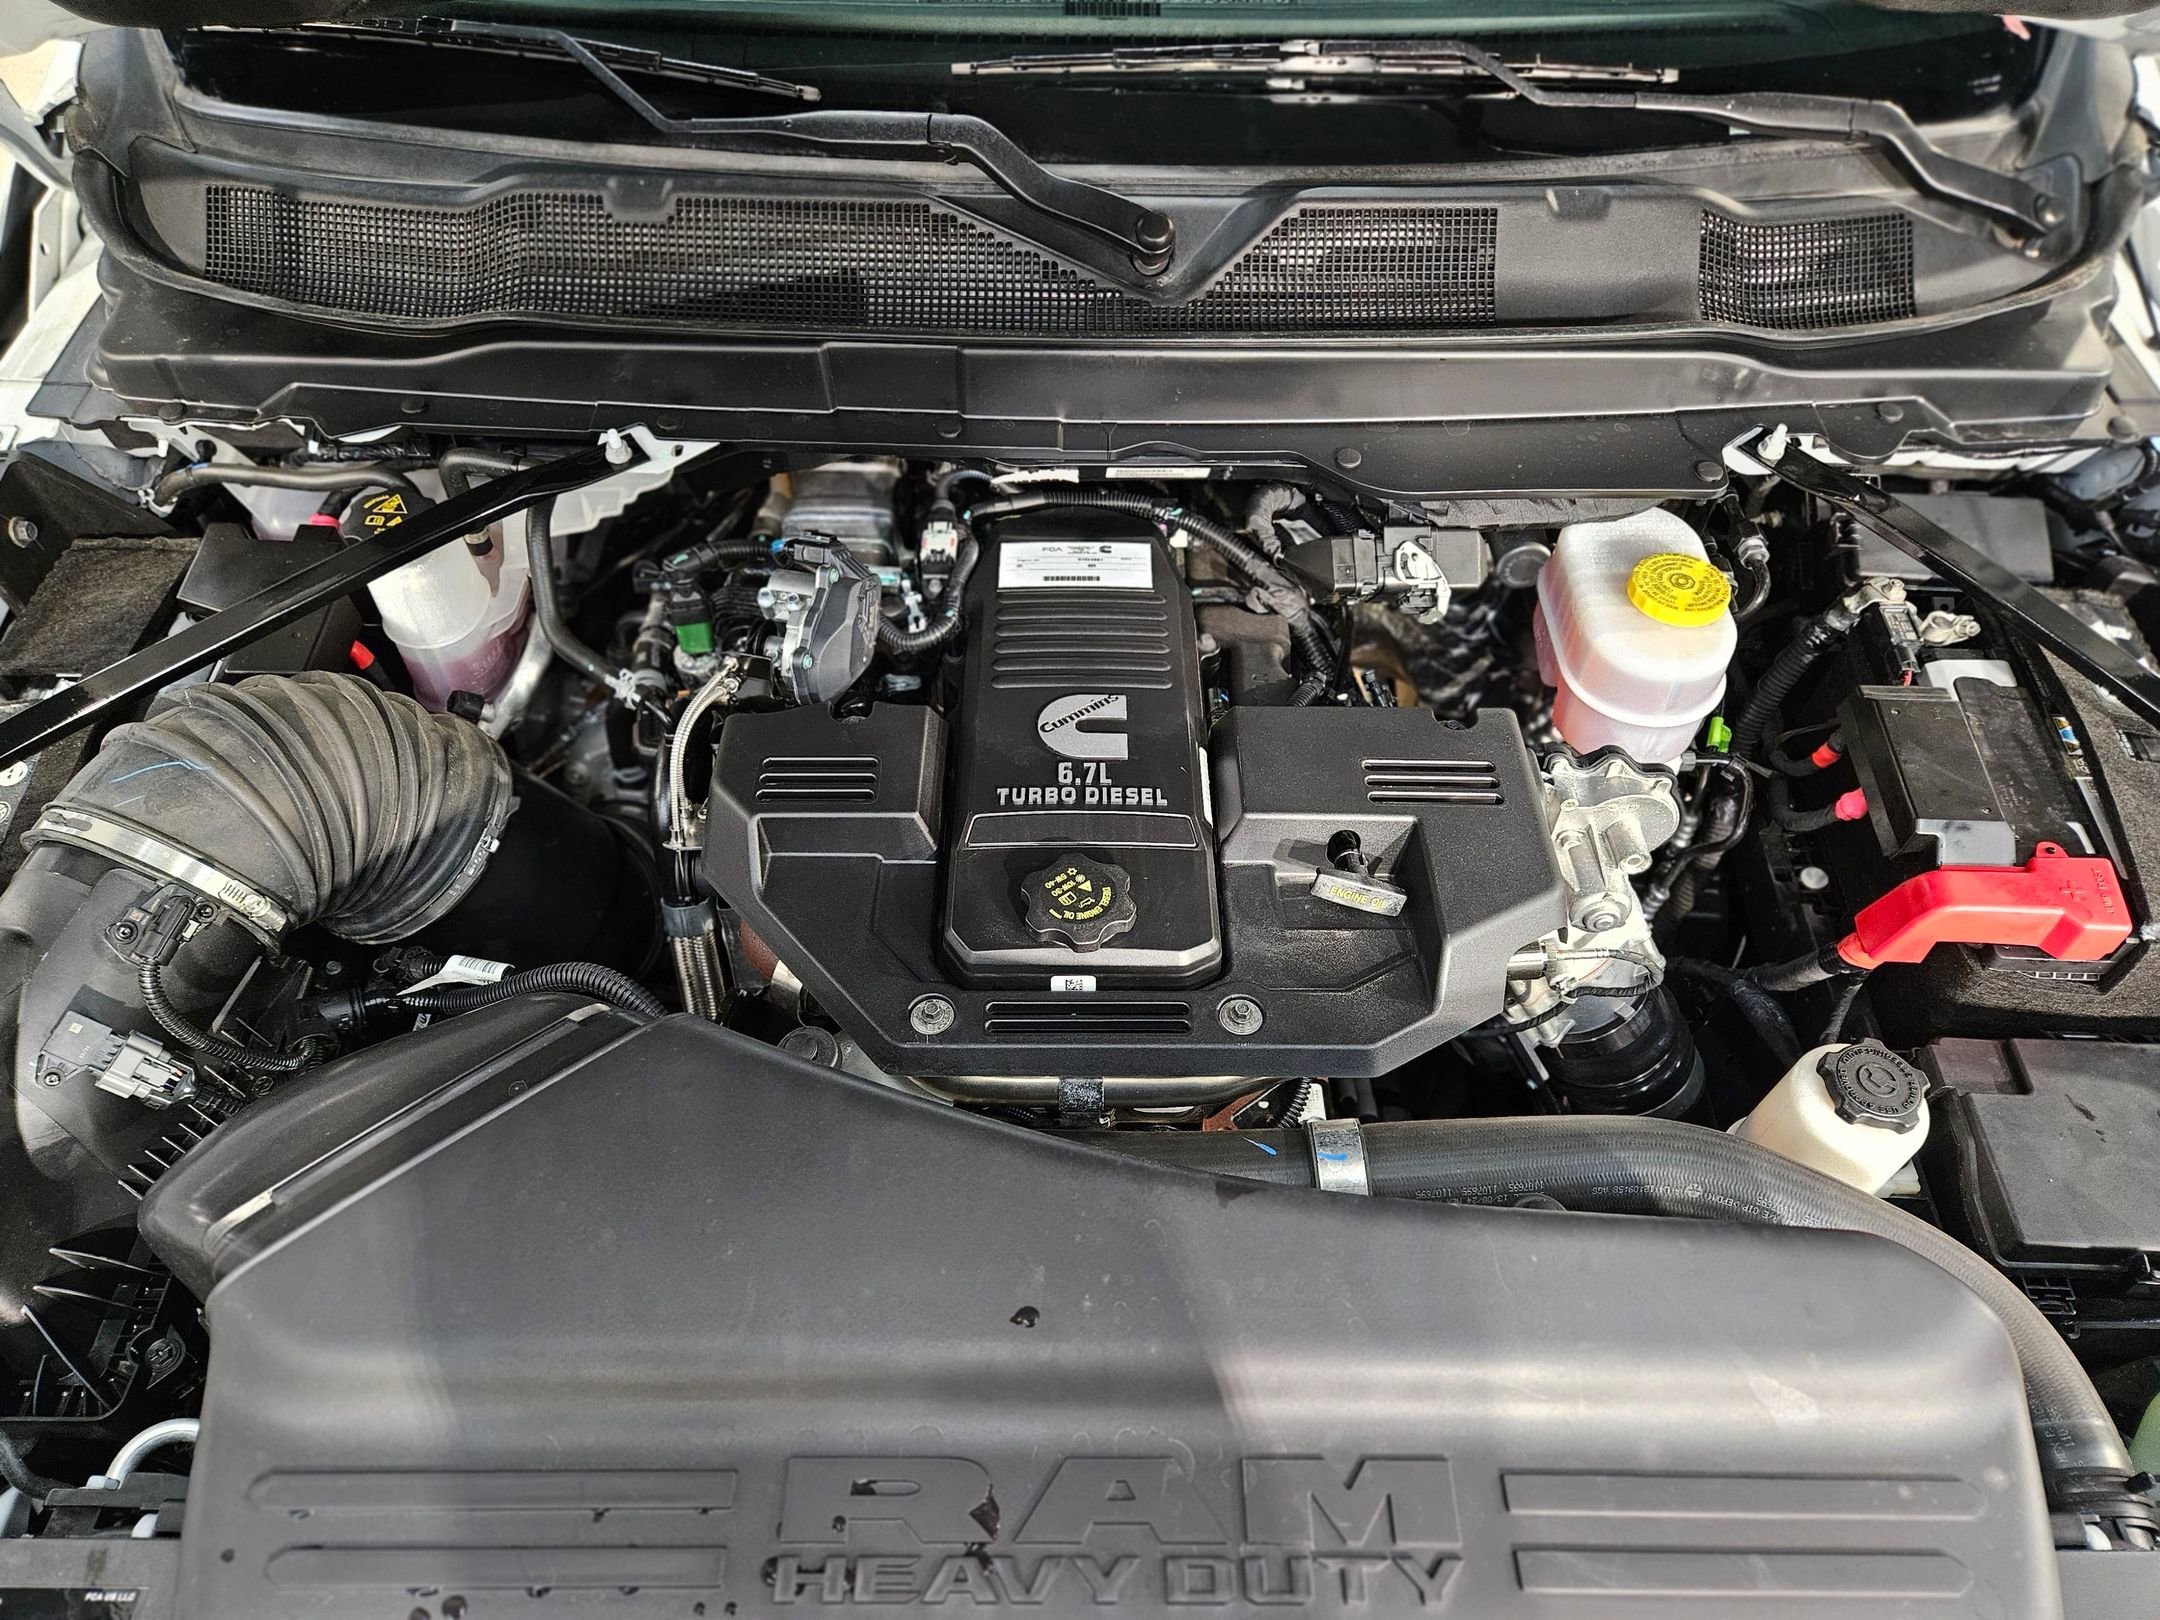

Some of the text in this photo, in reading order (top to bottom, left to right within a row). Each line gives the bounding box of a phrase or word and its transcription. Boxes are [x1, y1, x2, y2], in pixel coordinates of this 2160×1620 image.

[1039, 693, 1119, 733] Cummins
[1058, 762, 1112, 785] 6.7L
[997, 787, 1168, 806] TURBO DIESEL
[1329, 886, 1387, 909] ENGINE OIL
[1063, 910, 1075, 920] OIL
[1076, 905, 1103, 920] ENGINE
[1878, 1105, 1899, 1114] USE
[778, 1455, 1462, 1547] RAM
[771, 1554, 1465, 1605] HEAVY DUTY
